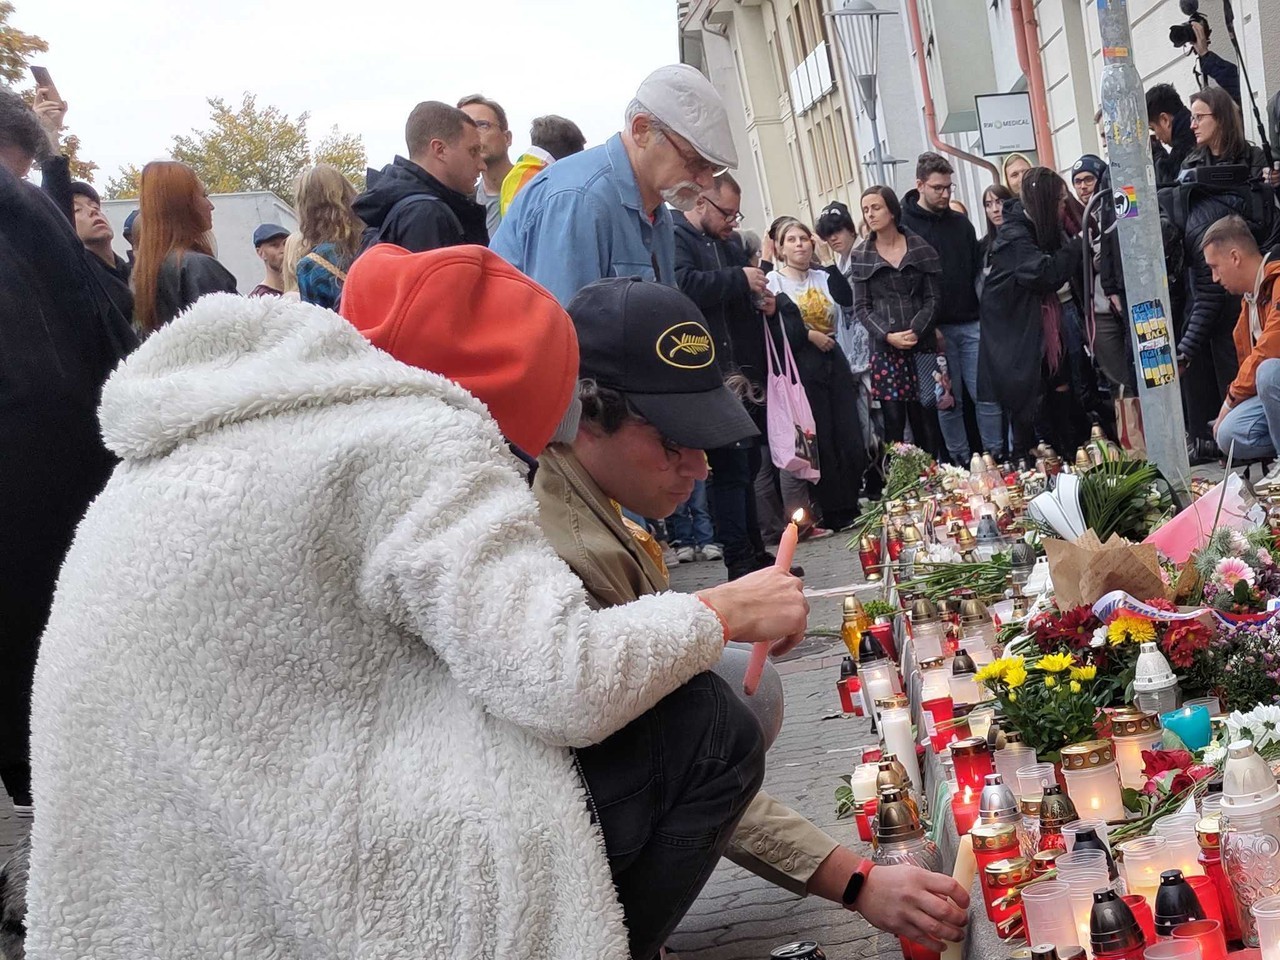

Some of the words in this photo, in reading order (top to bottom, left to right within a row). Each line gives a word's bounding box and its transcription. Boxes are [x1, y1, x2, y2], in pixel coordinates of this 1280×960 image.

[1003, 119, 1029, 127] MEDICAL
[1146, 328, 1167, 341] BACK
[1154, 374, 1175, 386] BACK
